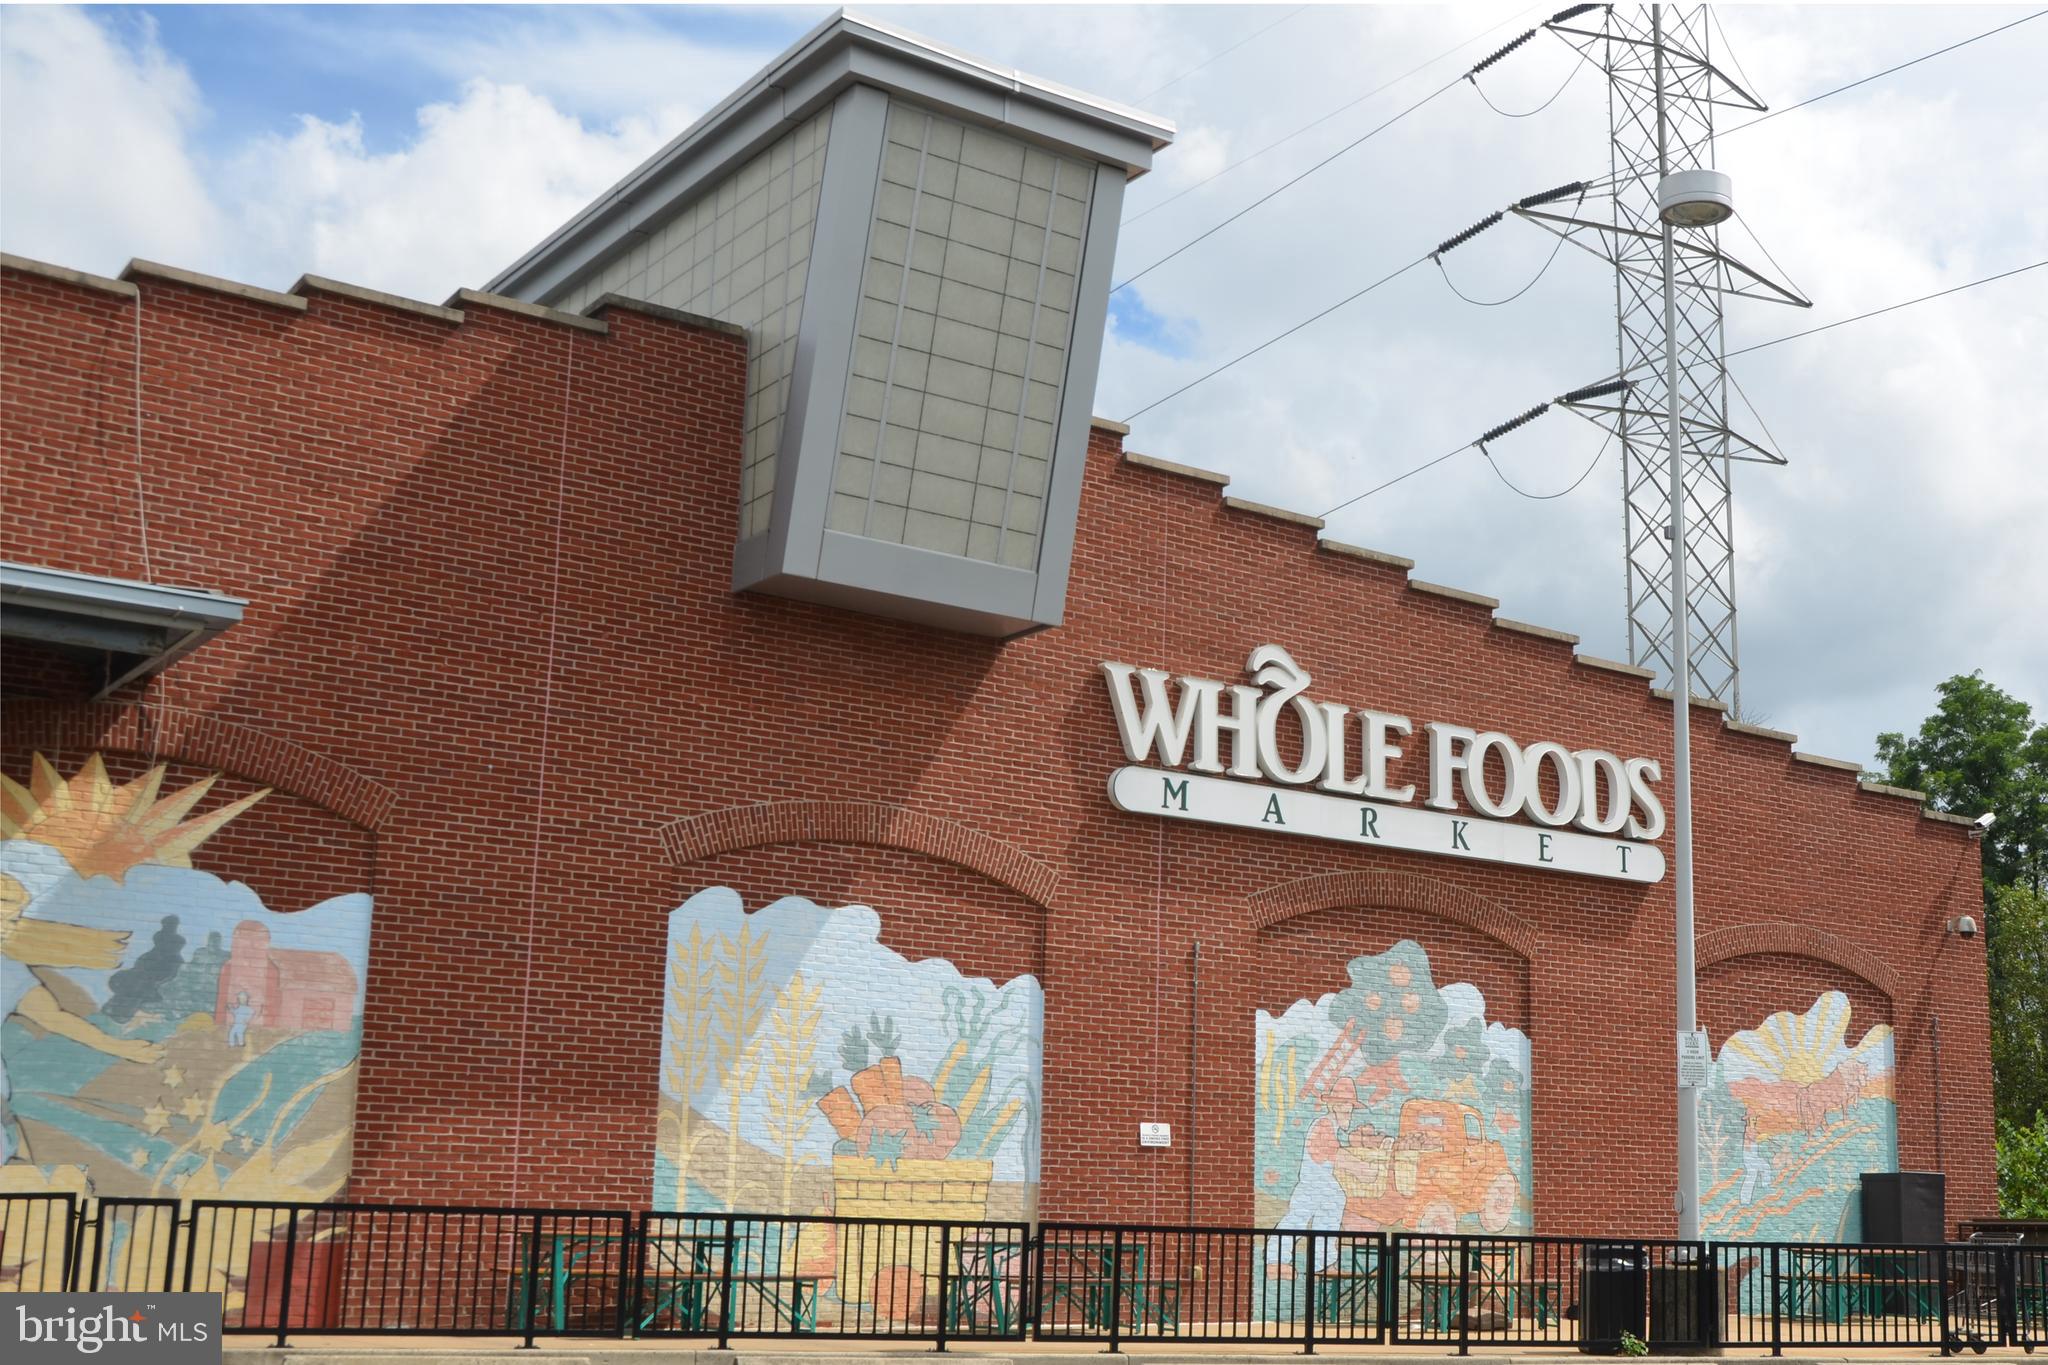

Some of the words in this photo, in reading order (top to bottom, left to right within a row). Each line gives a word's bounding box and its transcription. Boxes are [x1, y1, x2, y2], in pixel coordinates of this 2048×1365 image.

[1098, 643, 1416, 803] WHOLE
[1424, 721, 1666, 841] FOODS
[1161, 776, 1632, 873] MARKET
